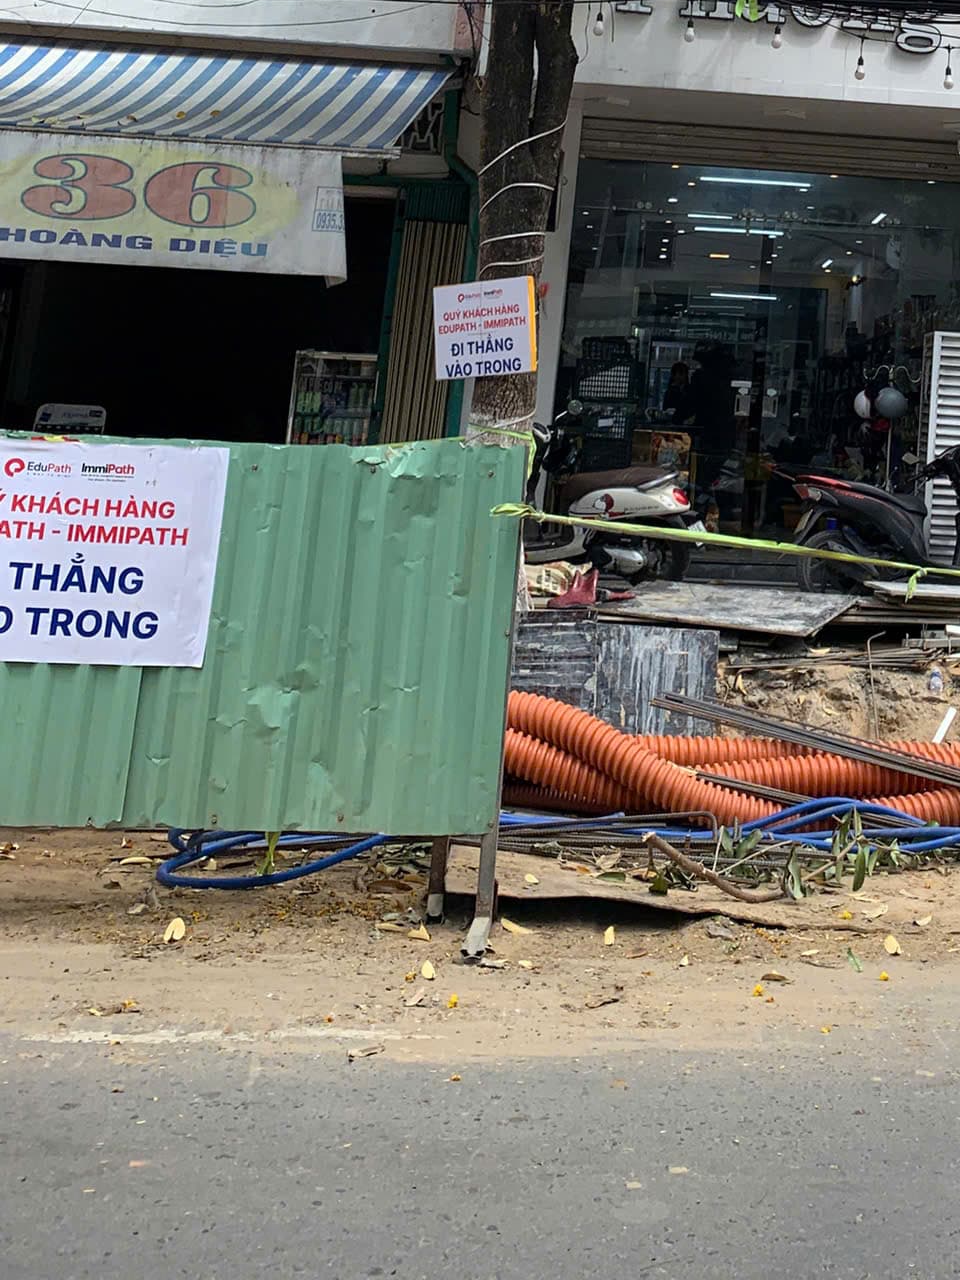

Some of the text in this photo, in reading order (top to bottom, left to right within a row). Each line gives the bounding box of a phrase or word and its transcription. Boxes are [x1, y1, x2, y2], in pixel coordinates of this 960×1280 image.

[21, 153, 256, 228] 36
[0, 228, 268, 258] HOÀNG DIỆU
[439, 322, 477, 336] EDUPATH
[484, 316, 526, 330] IMMIPATH
[451, 342, 464, 357] ĐI
[476, 357, 521, 375] TRONG
[27, 460, 135, 475] EduPath ImmiPath
[11, 491, 99, 517] KHÁCH
[105, 495, 175, 519] HÀNG
[67, 524, 189, 546] IMMIPATH
[9, 553, 144, 595] THẲNG
[26, 607, 159, 639] TRONG
